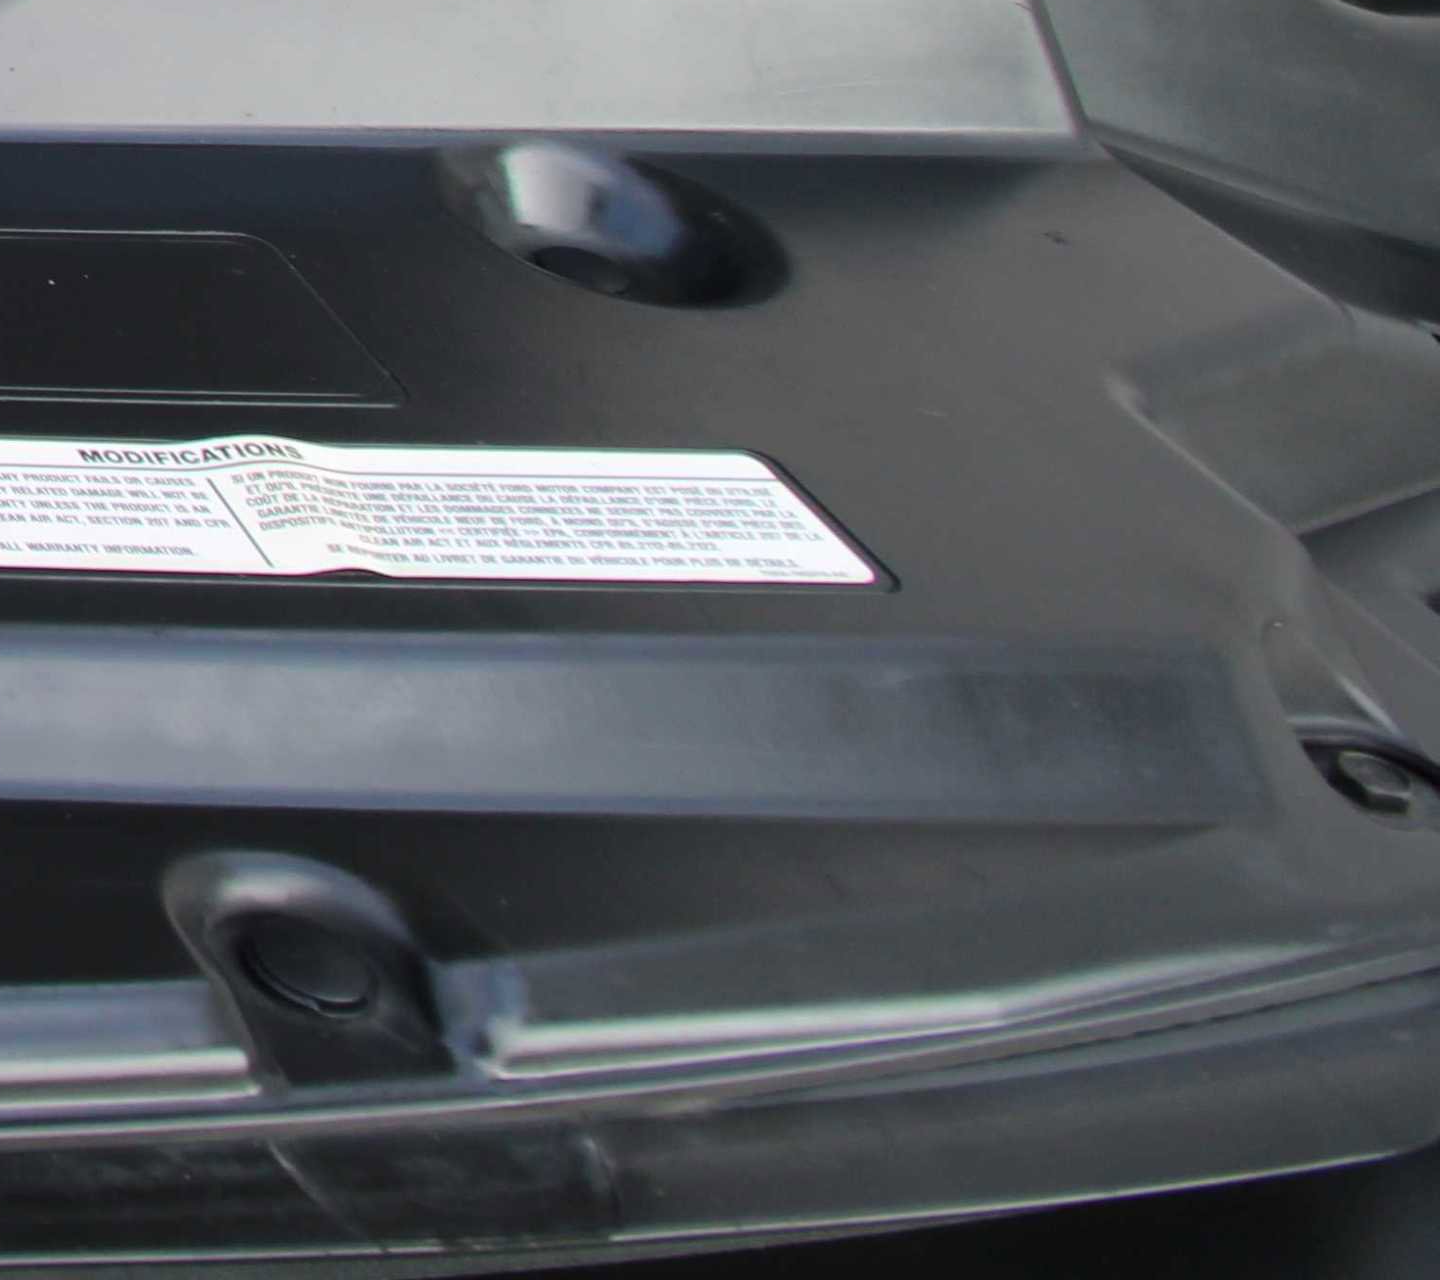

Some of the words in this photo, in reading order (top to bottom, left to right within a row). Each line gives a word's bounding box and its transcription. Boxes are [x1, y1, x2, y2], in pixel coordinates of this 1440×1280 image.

[77, 442, 304, 465] MODIFICATIONS
[22, 473, 80, 482] PRODUCT
[84, 502, 108, 511] THE
[111, 503, 171, 513] PRODUCT
